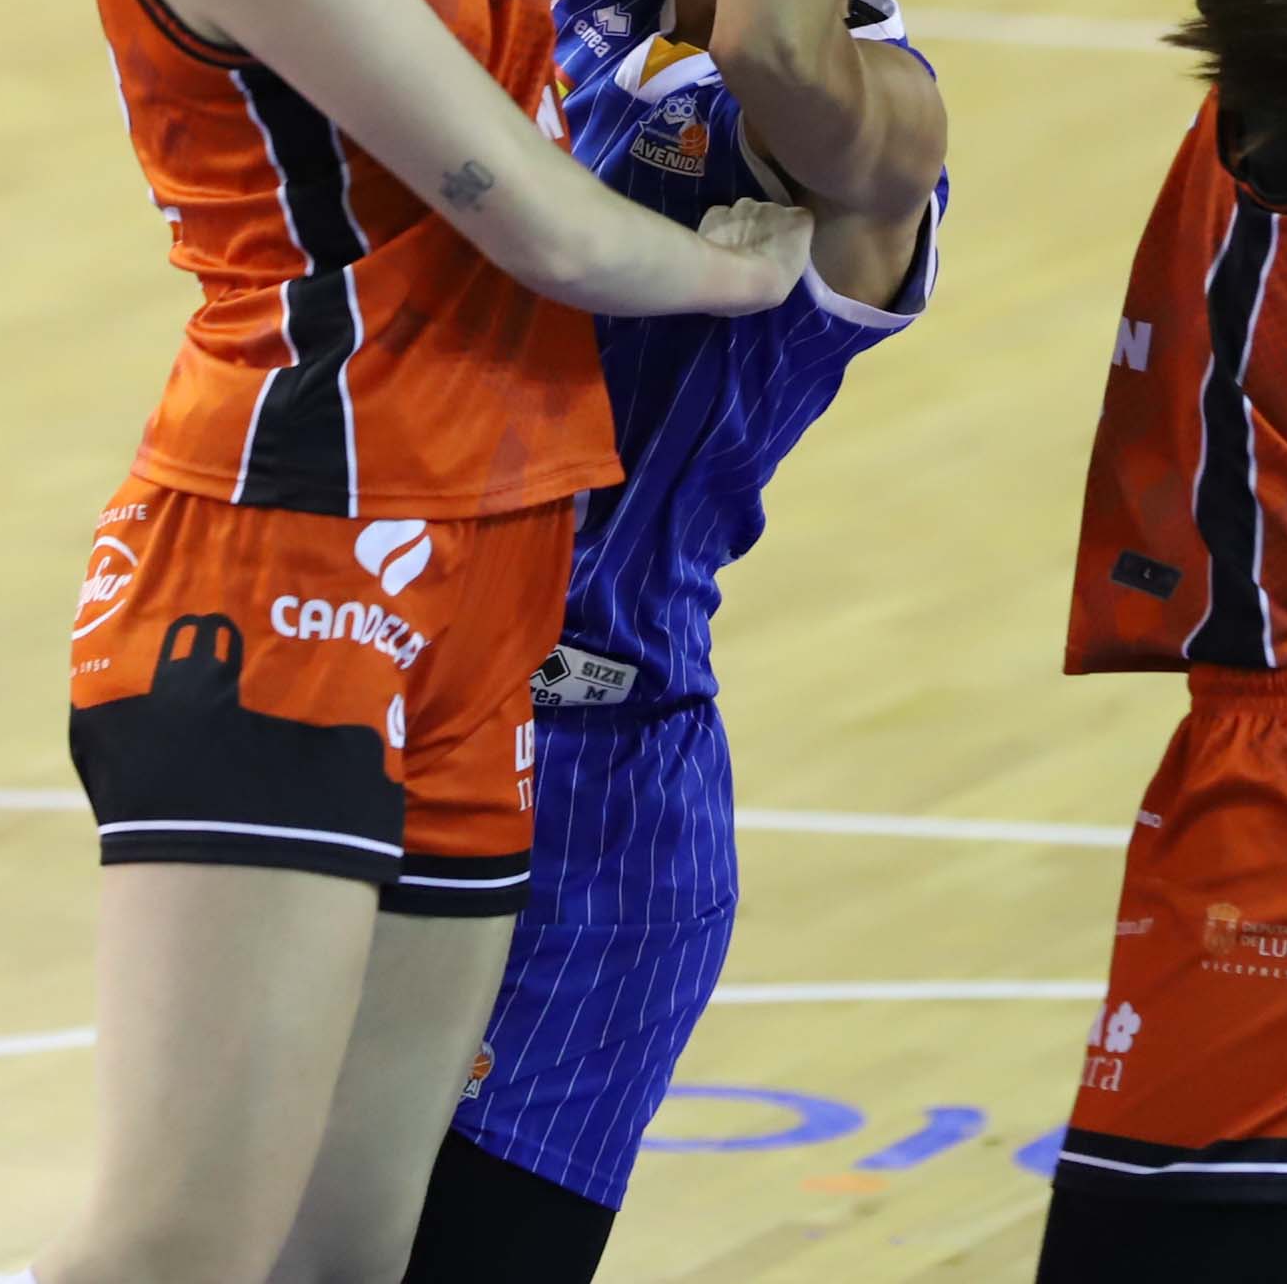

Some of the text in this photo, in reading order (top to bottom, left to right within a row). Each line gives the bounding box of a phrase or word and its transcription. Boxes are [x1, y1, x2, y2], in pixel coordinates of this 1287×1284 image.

[573, 18, 611, 59] errea
[632, 137, 706, 176] AVENIDA
[270, 595, 430, 670] CANDELA
[580, 660, 628, 688] SIZE
[583, 684, 608, 702] M
